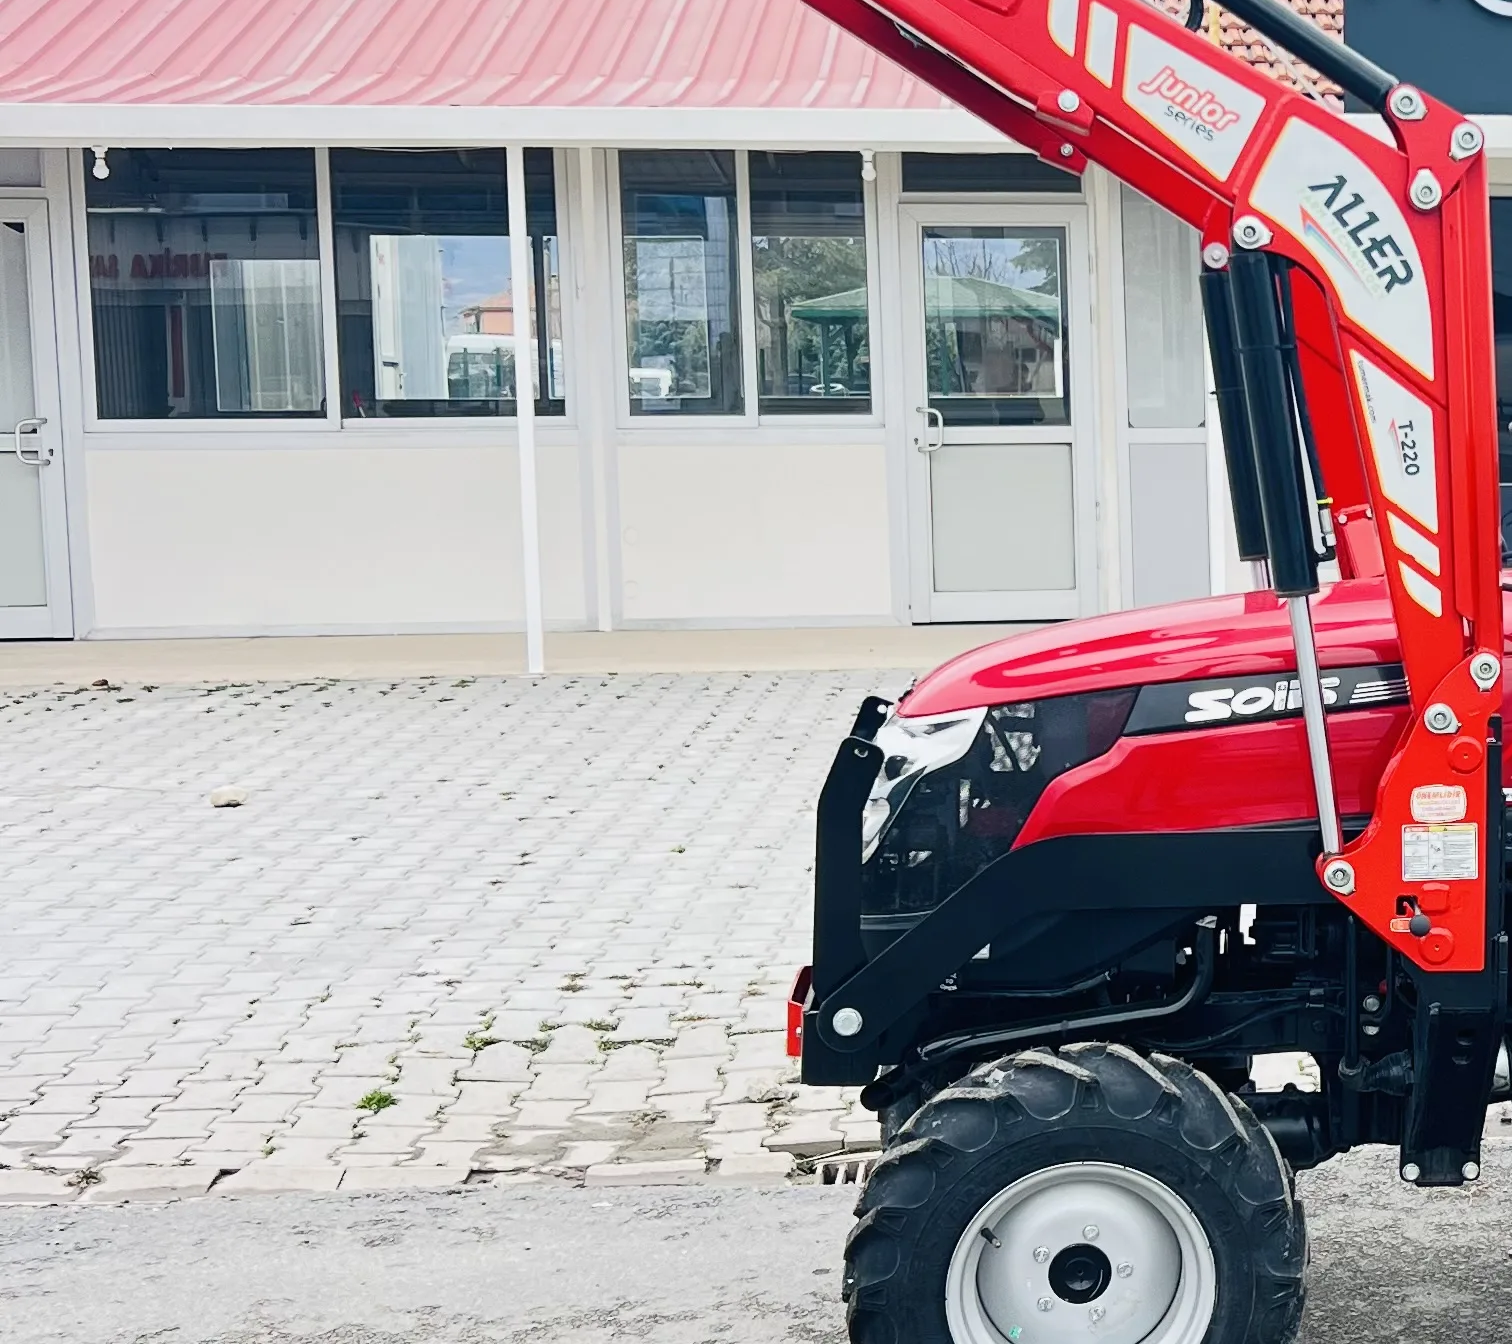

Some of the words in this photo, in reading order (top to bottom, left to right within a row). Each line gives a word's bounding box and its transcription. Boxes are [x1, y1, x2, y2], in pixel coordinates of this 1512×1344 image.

[1138, 65, 1240, 131] junior
[1164, 105, 1215, 142] series
[1307, 174, 1413, 295] ALLER
[1398, 420, 1420, 476] T-220
